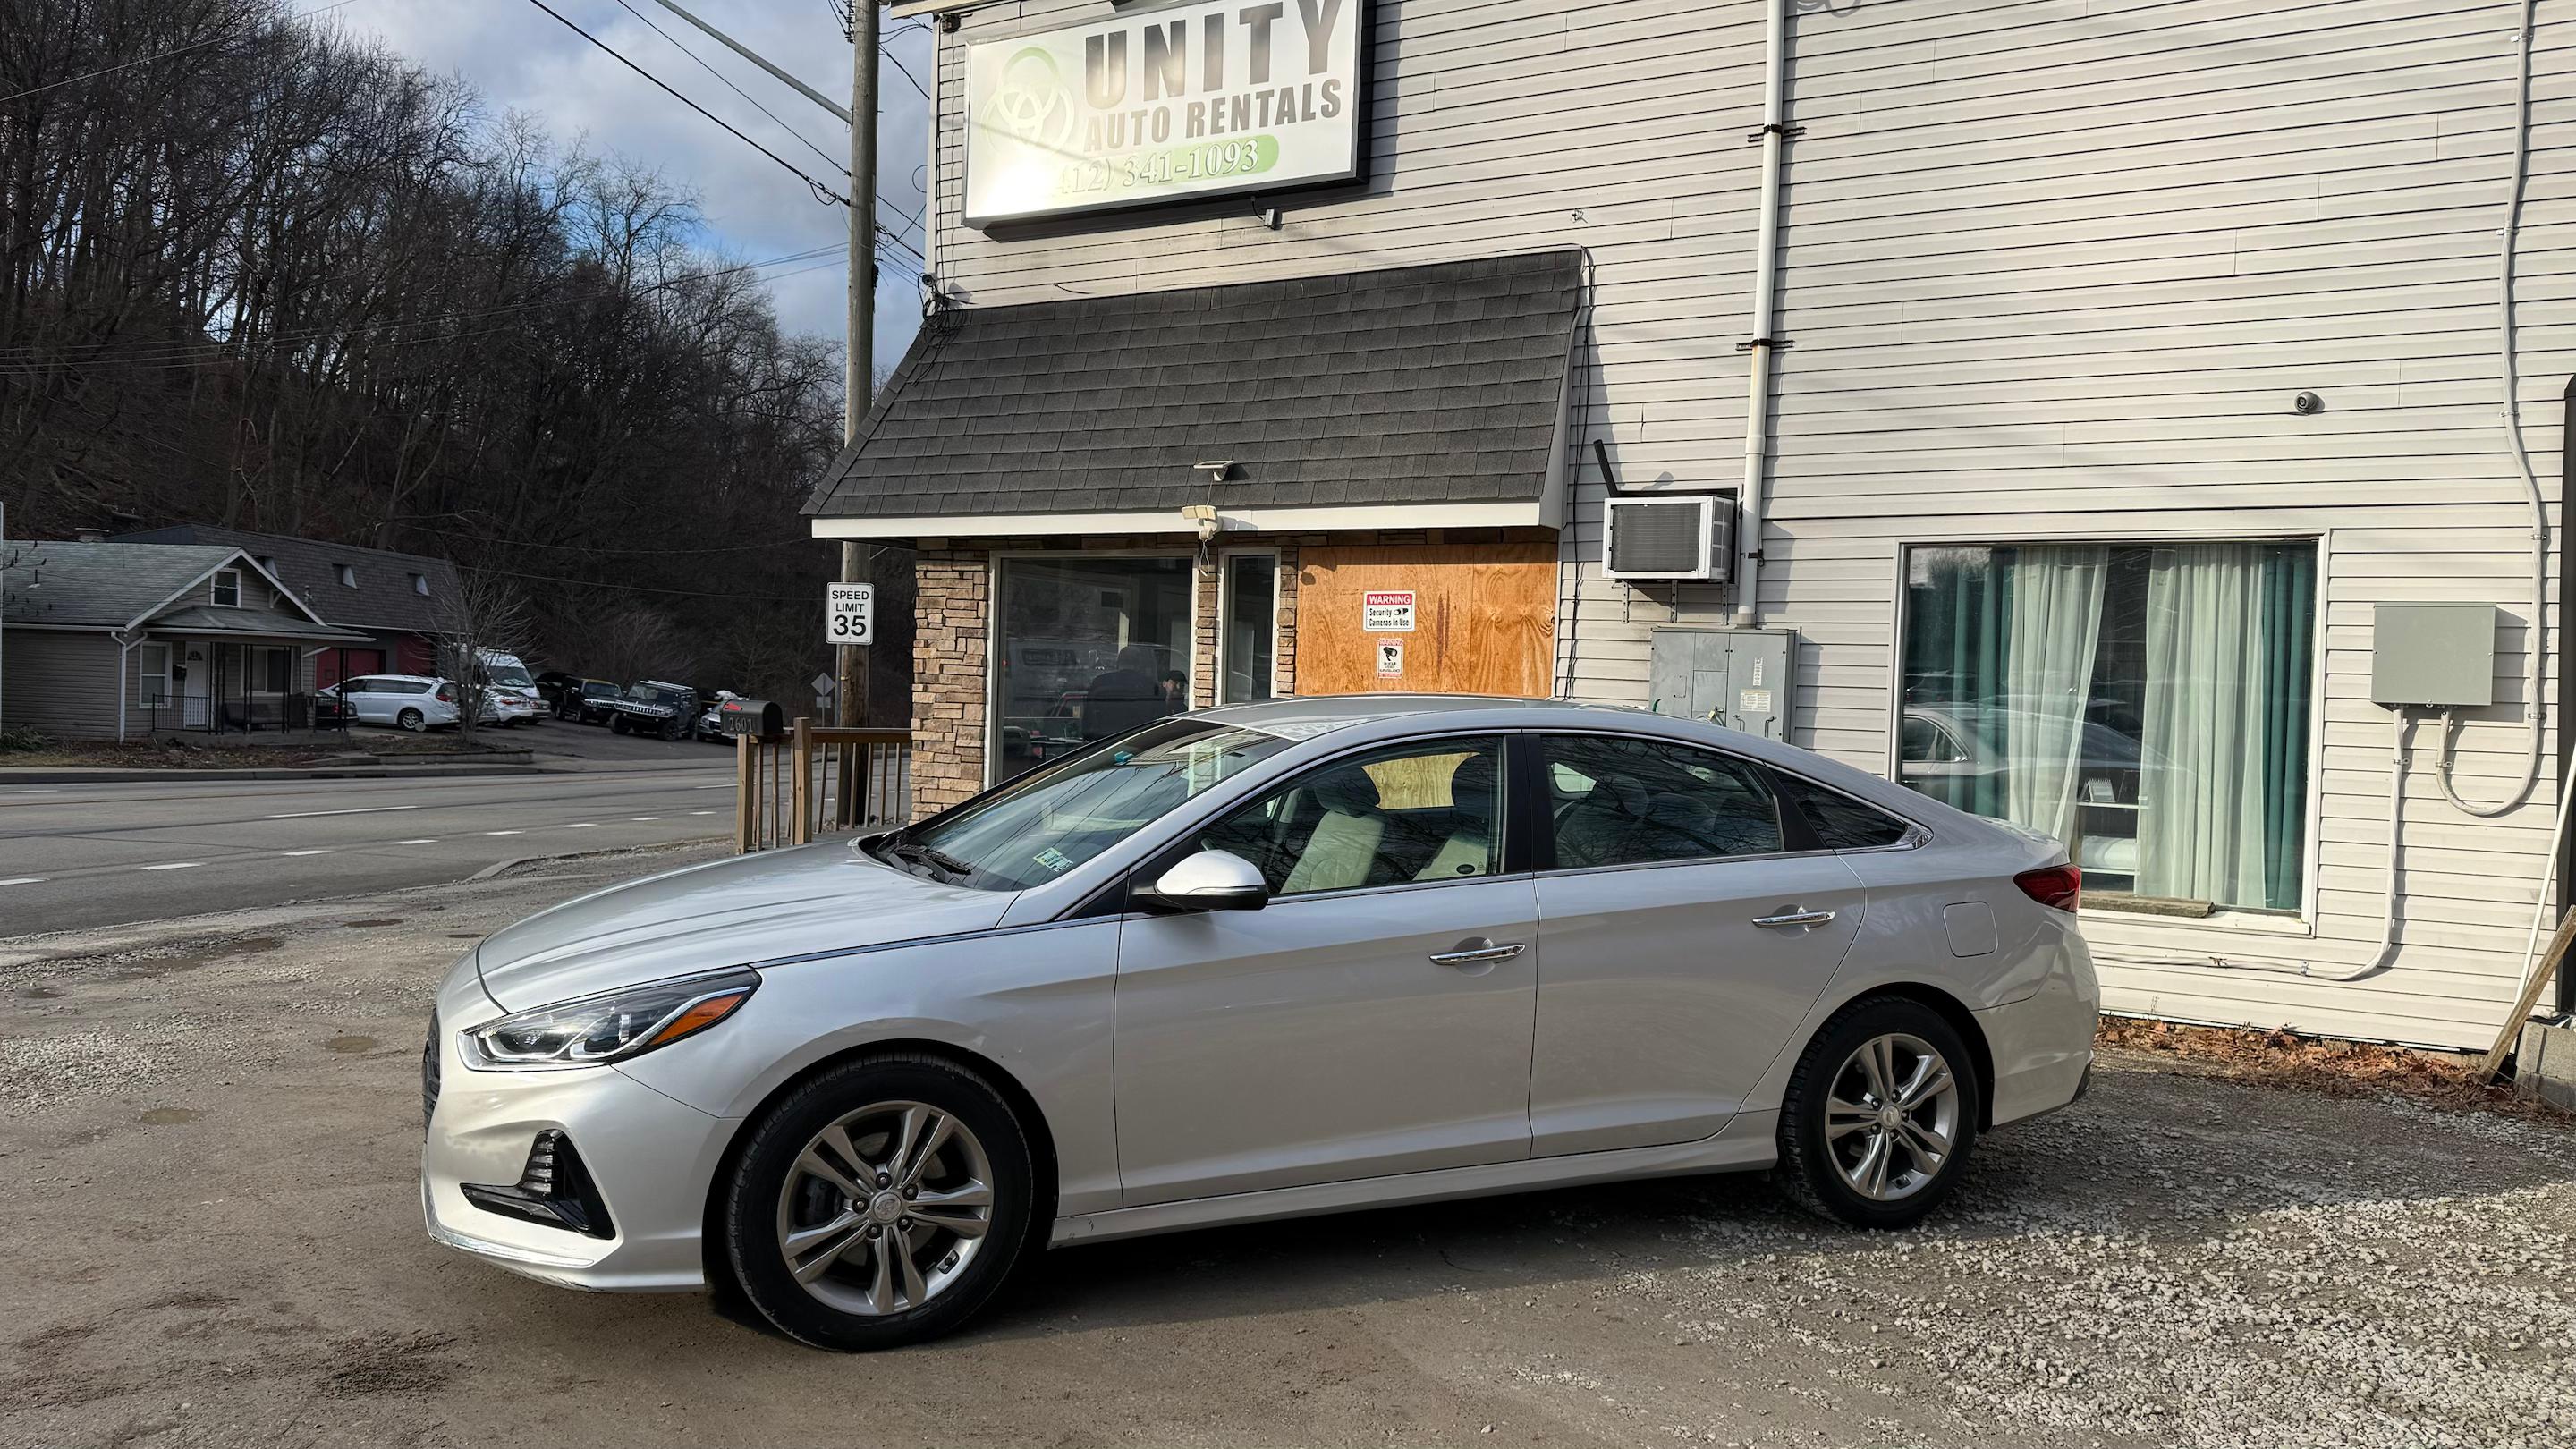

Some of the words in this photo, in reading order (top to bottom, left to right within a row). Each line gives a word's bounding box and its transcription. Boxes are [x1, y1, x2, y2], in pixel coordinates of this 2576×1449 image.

[1085, 0, 1342, 110] UNITY
[1084, 106, 1171, 153] AUTO
[1185, 78, 1342, 139] RENTALS
[1123, 139, 1258, 187] 341-1093
[832, 590, 869, 600] SPEED
[1369, 595, 1411, 604] WARNING
[835, 602, 865, 613] LIMIT
[1369, 607, 1393, 618] Security
[834, 614, 866, 636] 35
[1369, 618, 1392, 626] Cameras
[1393, 618, 1399, 627] In
[1400, 618, 1410, 627] Use
[729, 716, 753, 733] 2601
